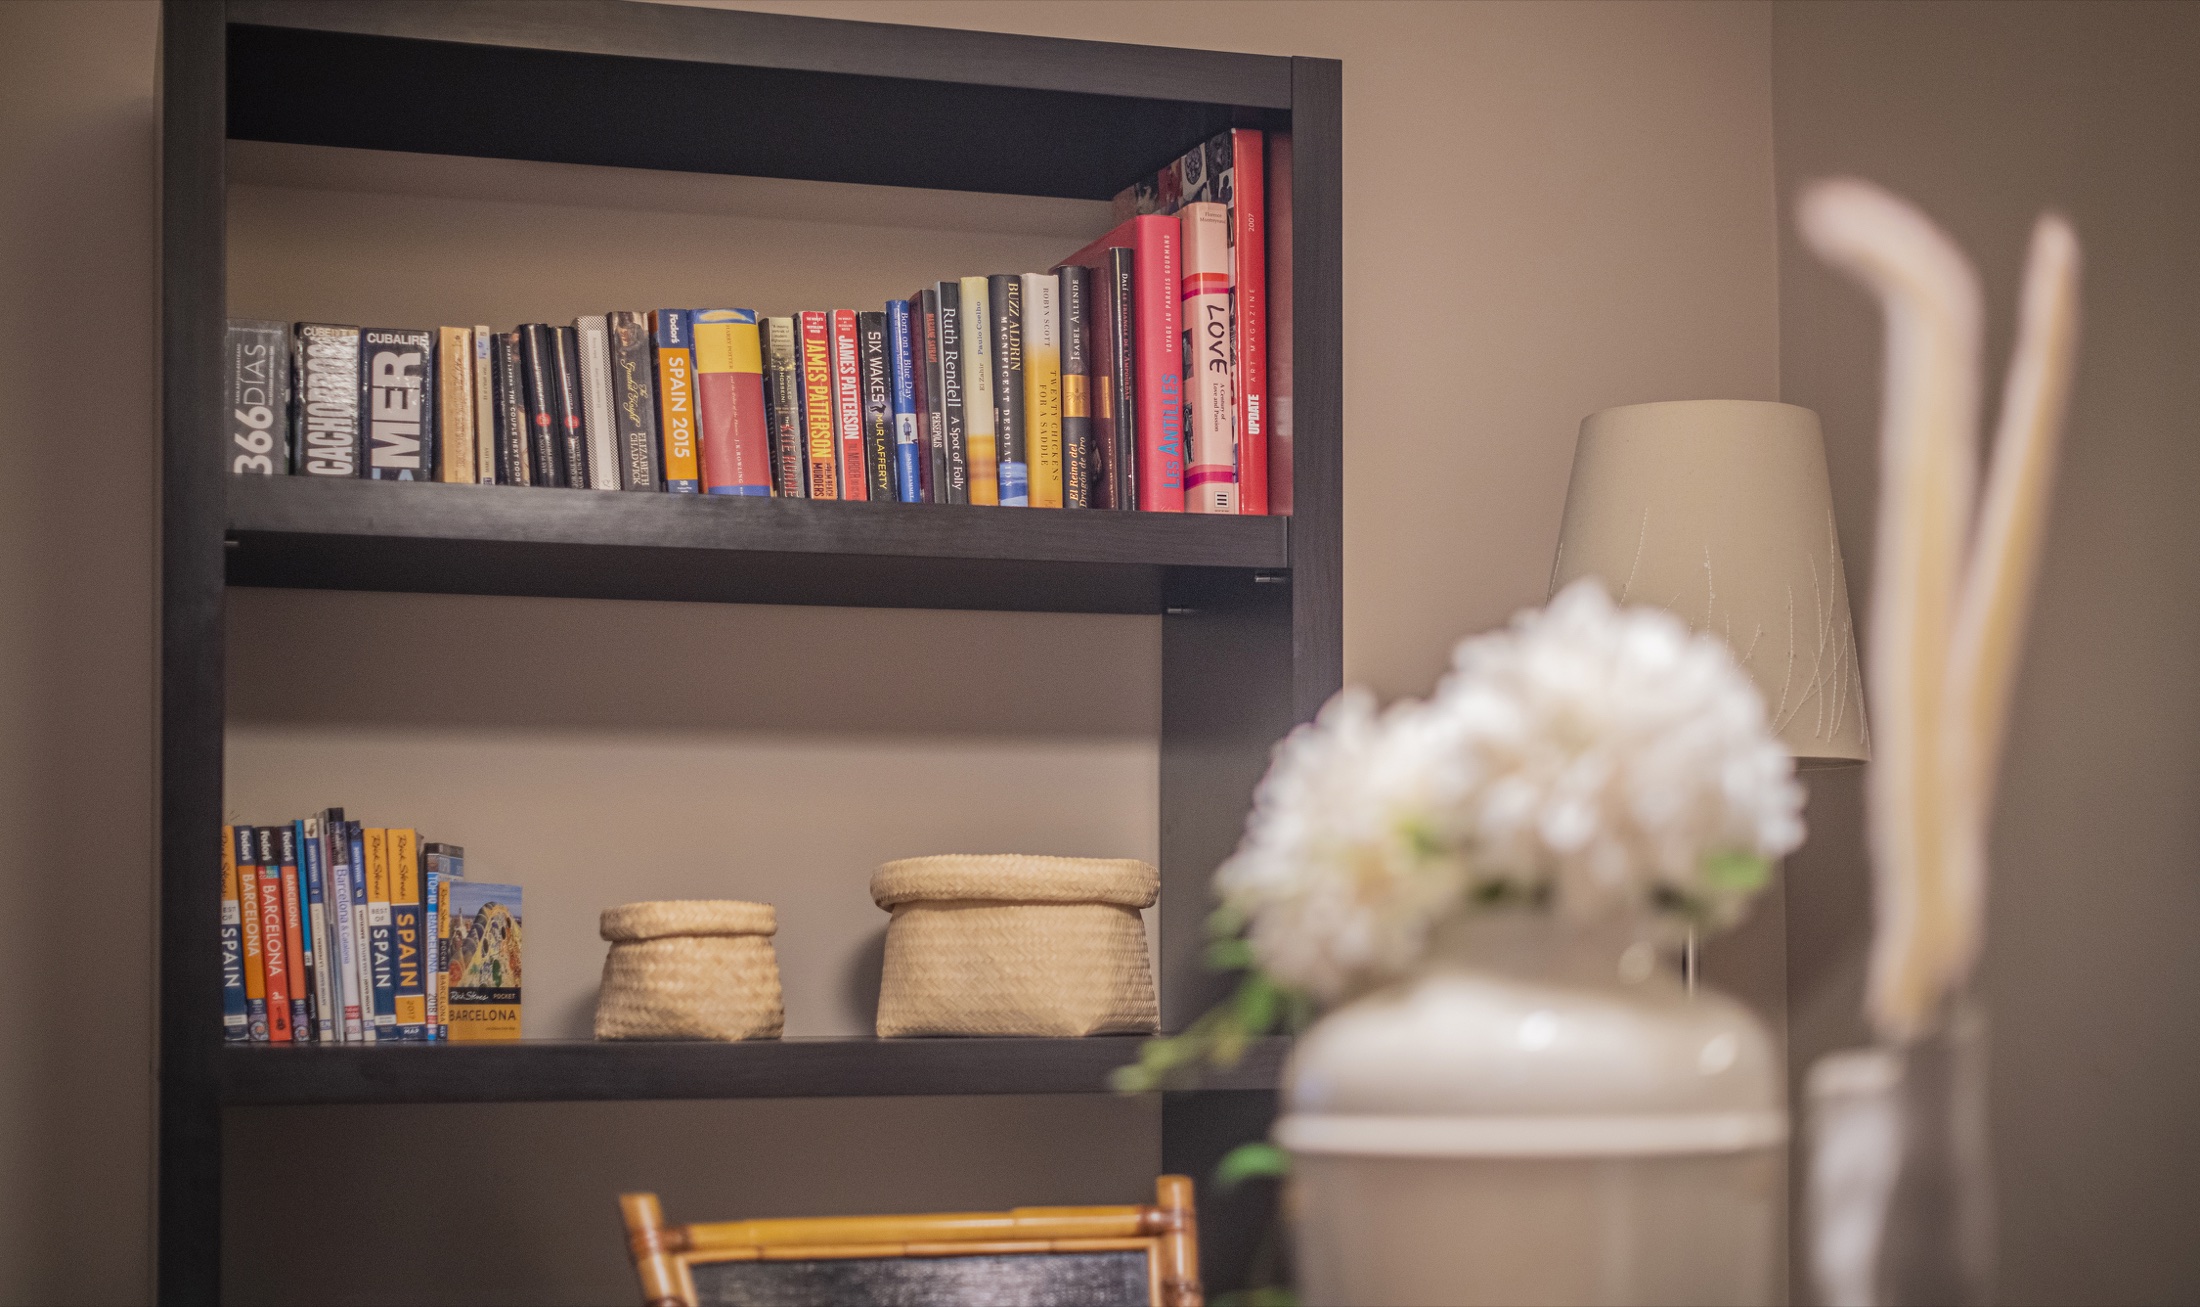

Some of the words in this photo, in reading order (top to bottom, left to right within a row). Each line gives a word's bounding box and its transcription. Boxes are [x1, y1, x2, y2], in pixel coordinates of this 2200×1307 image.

[1163, 234, 1171, 274] GOURMAND
[1008, 282, 1020, 317] BUZZ
[1070, 279, 1080, 325] ALLENDE
[1165, 312, 1171, 322] AU
[669, 313, 680, 344] Fodor's
[868, 331, 881, 353] SIX
[901, 312, 909, 334] Born
[903, 336, 909, 348] on
[943, 307, 955, 344] Ruth
[1070, 327, 1080, 361] ISABEL
[1206, 304, 1228, 376] LOVE
[806, 339, 827, 383] JAMES
[838, 335, 855, 375] JAMES
[1000, 316, 1010, 403] MAGNIFICENT
[1010, 320, 1021, 371] ALDRIN
[240, 344, 267, 405] DÍAS
[668, 357, 686, 412] SPAIN
[870, 357, 885, 402] WAKES
[903, 359, 911, 378] Blue
[945, 351, 961, 407] Rendell
[371, 351, 421, 469] MER
[841, 376, 859, 440] PATTERSON
[902, 381, 913, 399] Day
[1039, 384, 1047, 406] FOR
[809, 385, 832, 458] PATTERSON
[875, 414, 884, 438] MUR
[932, 412, 942, 448] PERSEPOLIS
[1157, 373, 1179, 457] ANTILLES
[1247, 393, 1260, 435] UPDATE
[233, 405, 273, 475] 366
[509, 406, 517, 437] COUPLE
[513, 461, 521, 482] DOOR
[630, 433, 640, 484] CHADWICK
[638, 432, 649, 486] ELIZABETH
[673, 419, 690, 458] 2015
[780, 424, 796, 452] KITE
[950, 426, 959, 451] Spot
[952, 452, 960, 463] of
[1003, 406, 1012, 488] DESOLATION
[1041, 421, 1049, 466] SADDLE
[1051, 423, 1059, 482] CHICKENS
[1068, 443, 1078, 458] del
[1078, 436, 1086, 456] Oro
[782, 455, 799, 498] RUNNE
[813, 462, 824, 497] MURDERS
[848, 452, 860, 478] MURDER
[877, 439, 887, 490] LAFFERTY
[952, 465, 964, 491] Folly
[1069, 460, 1078, 488] Reino
[1163, 461, 1181, 489] LES
[1069, 490, 1079, 501] El
[1079, 471, 1088, 508] Dragón
[242, 873, 260, 957] BARCELONA
[285, 873, 298, 929] BARCELONA
[336, 868, 350, 924] Barcelona
[263, 885, 282, 977] BARCELONA
[397, 914, 418, 987] SPAIN
[427, 912, 438, 974] BARCELONA
[221, 928, 241, 987] SPAIN
[373, 928, 391, 988] SPAIN
[428, 993, 438, 1015] 2018
[449, 1009, 516, 1021] BARCELONA
